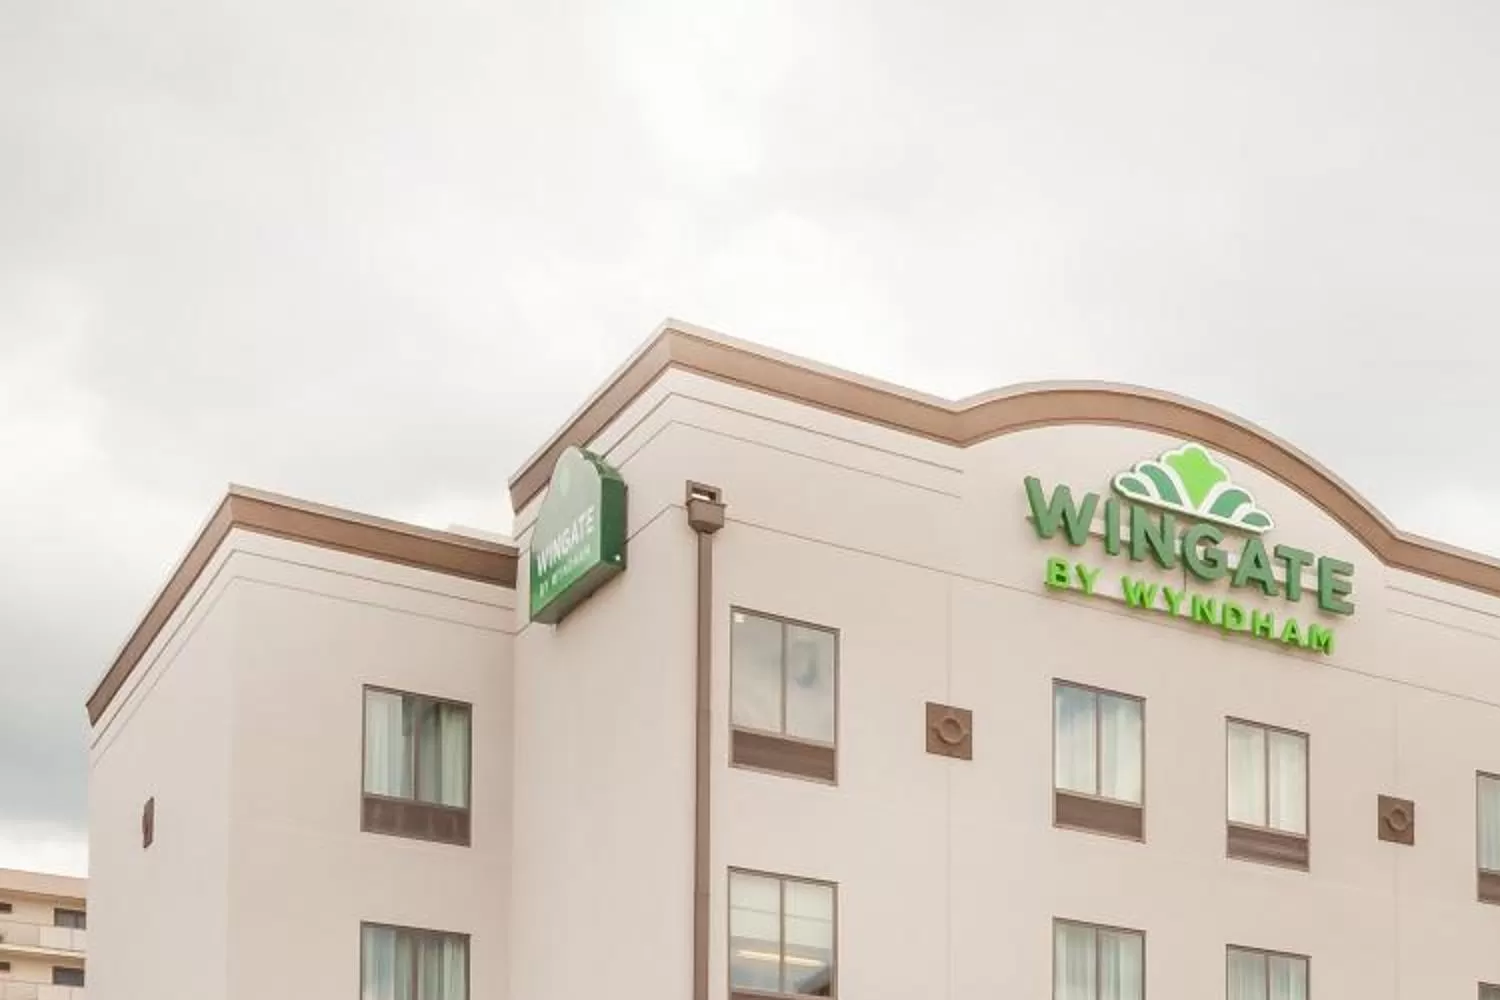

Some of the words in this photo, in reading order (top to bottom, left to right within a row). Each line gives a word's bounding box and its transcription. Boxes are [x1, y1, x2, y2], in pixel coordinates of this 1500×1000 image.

[537, 506, 595, 576] WINGATE
[1024, 476, 1354, 615] WINGATE
[1046, 556, 1101, 596] BY
[1122, 575, 1335, 656] WYNDHAM
